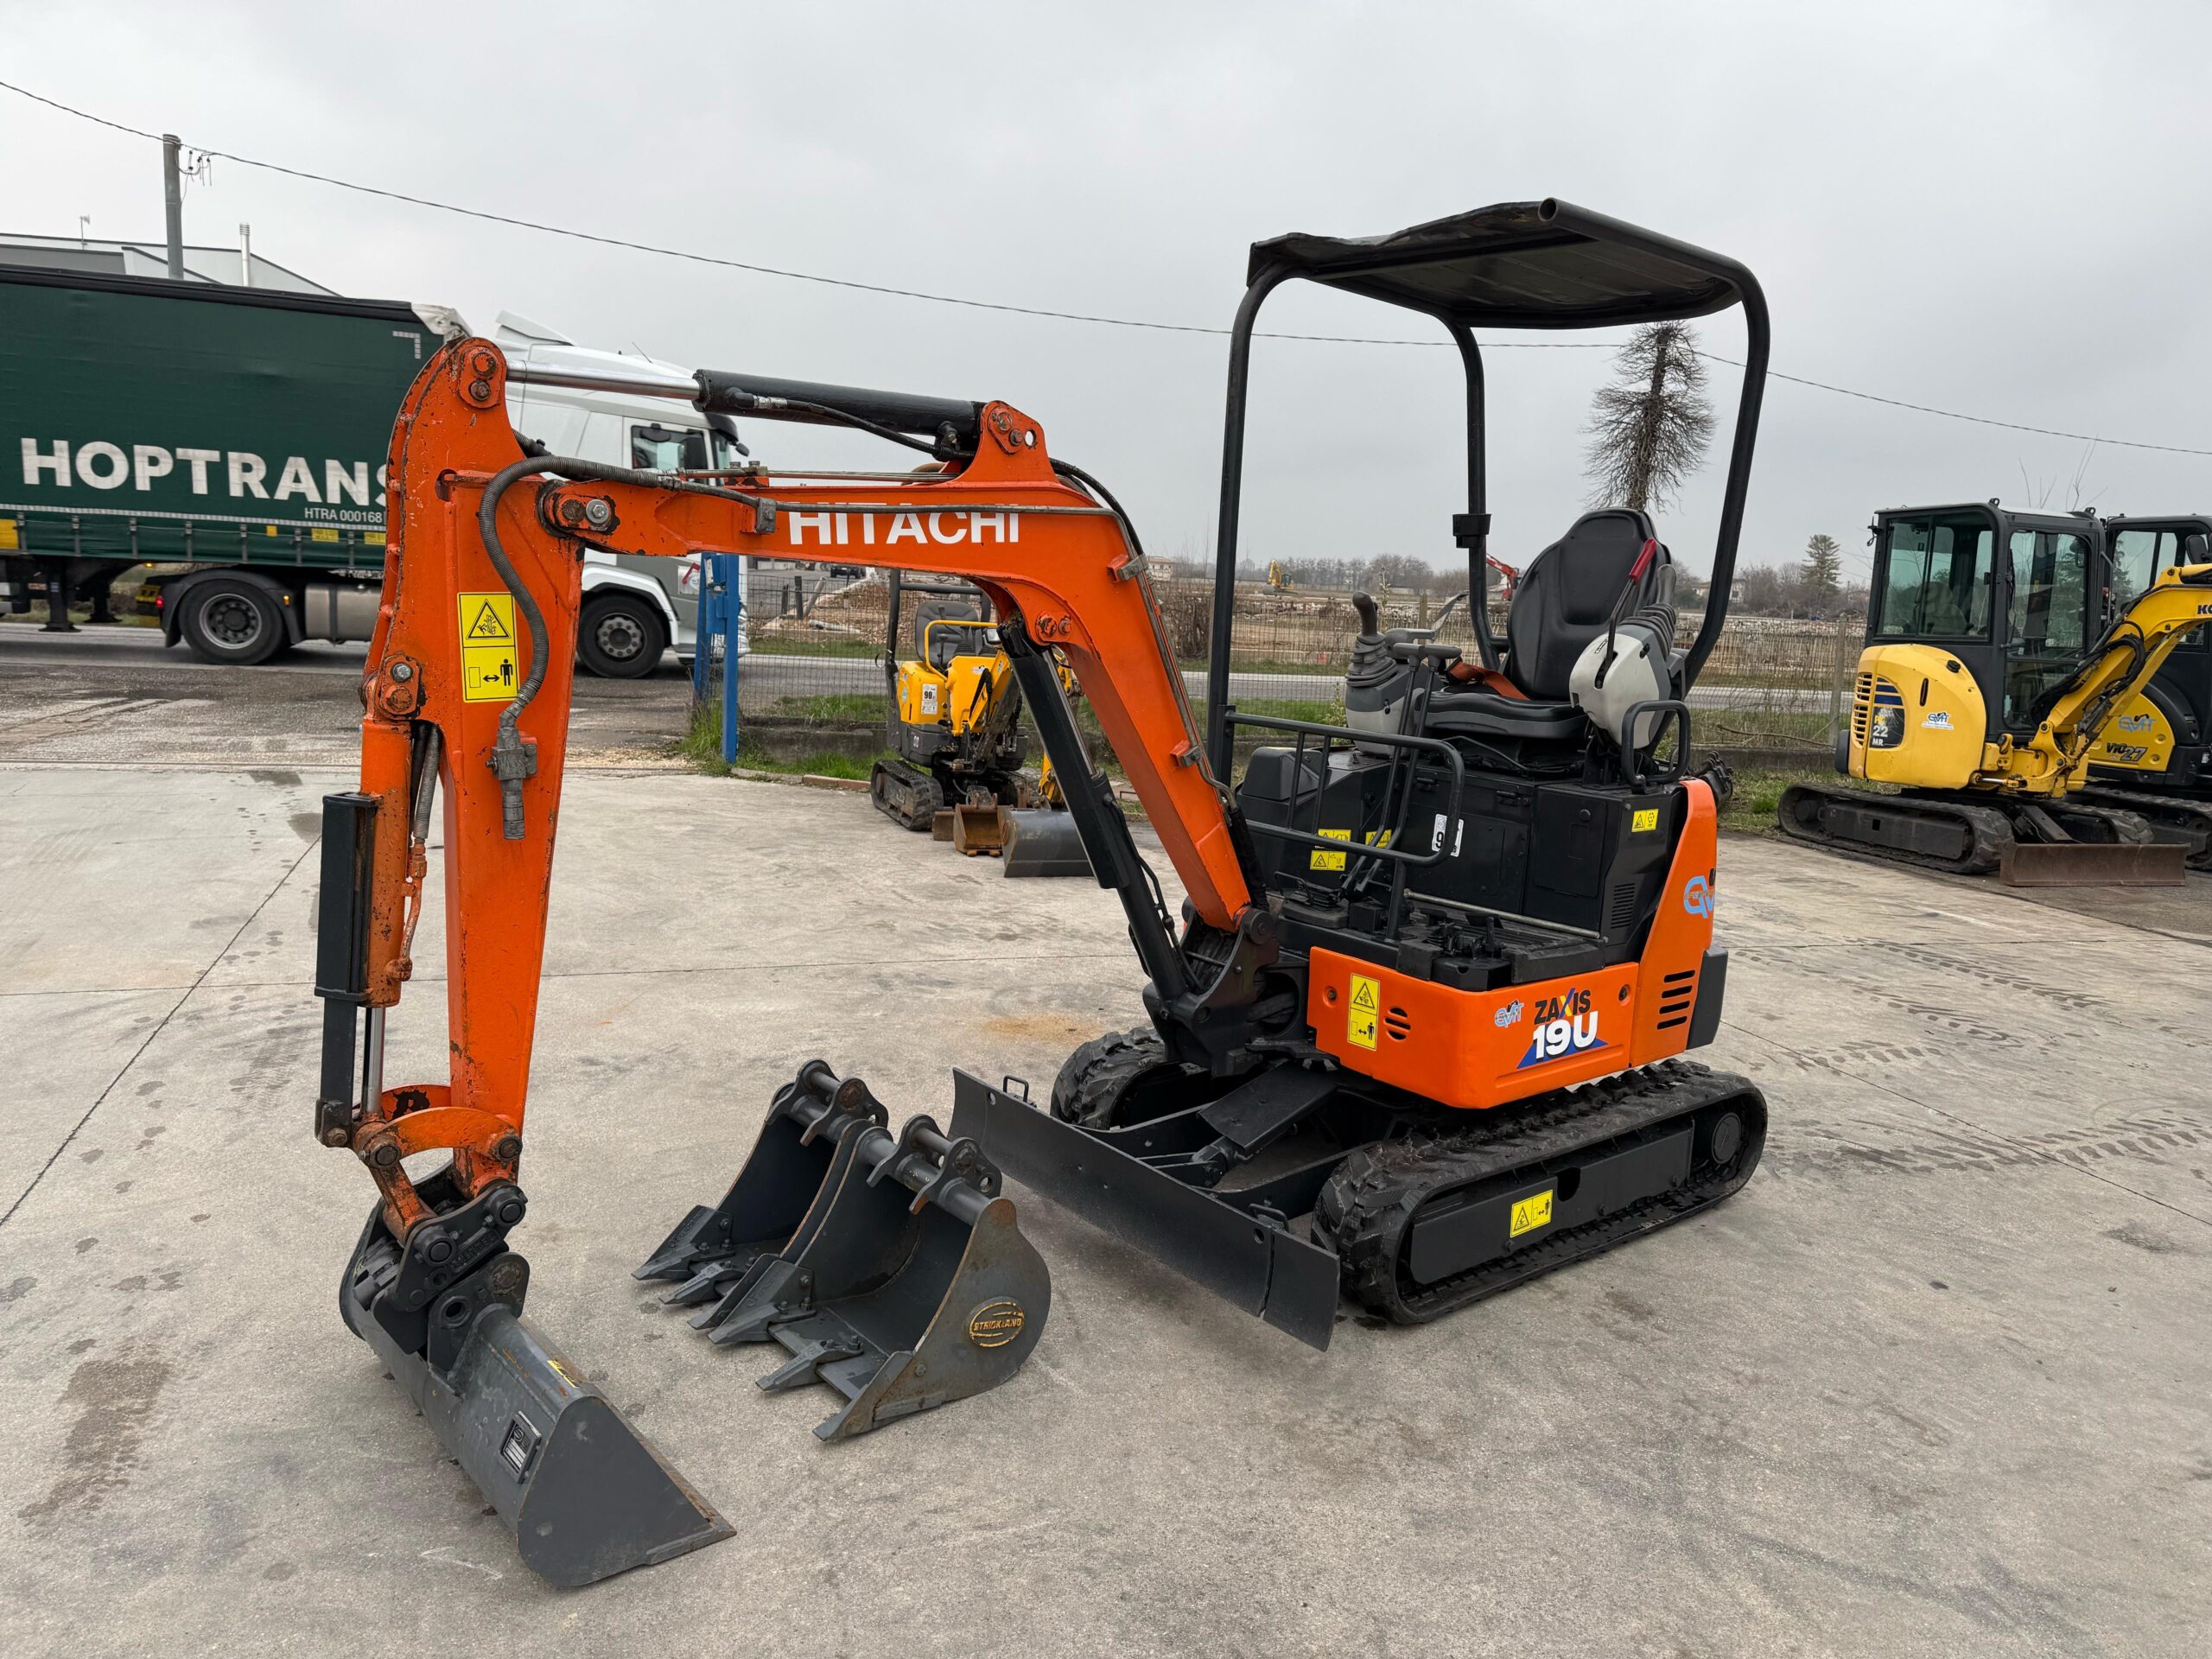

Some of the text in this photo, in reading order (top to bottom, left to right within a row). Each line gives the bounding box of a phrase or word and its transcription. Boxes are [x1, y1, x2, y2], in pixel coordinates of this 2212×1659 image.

[22, 438, 386, 506] HOPTRAN
[304, 507, 382, 524] HTRA 000168
[787, 501, 1020, 544] HITACHI
[1872, 738, 1884, 747] MR
[1873, 725, 1888, 738] 22
[1535, 988, 1592, 1025] ZAXIS
[1533, 1010, 1599, 1061] 19U
